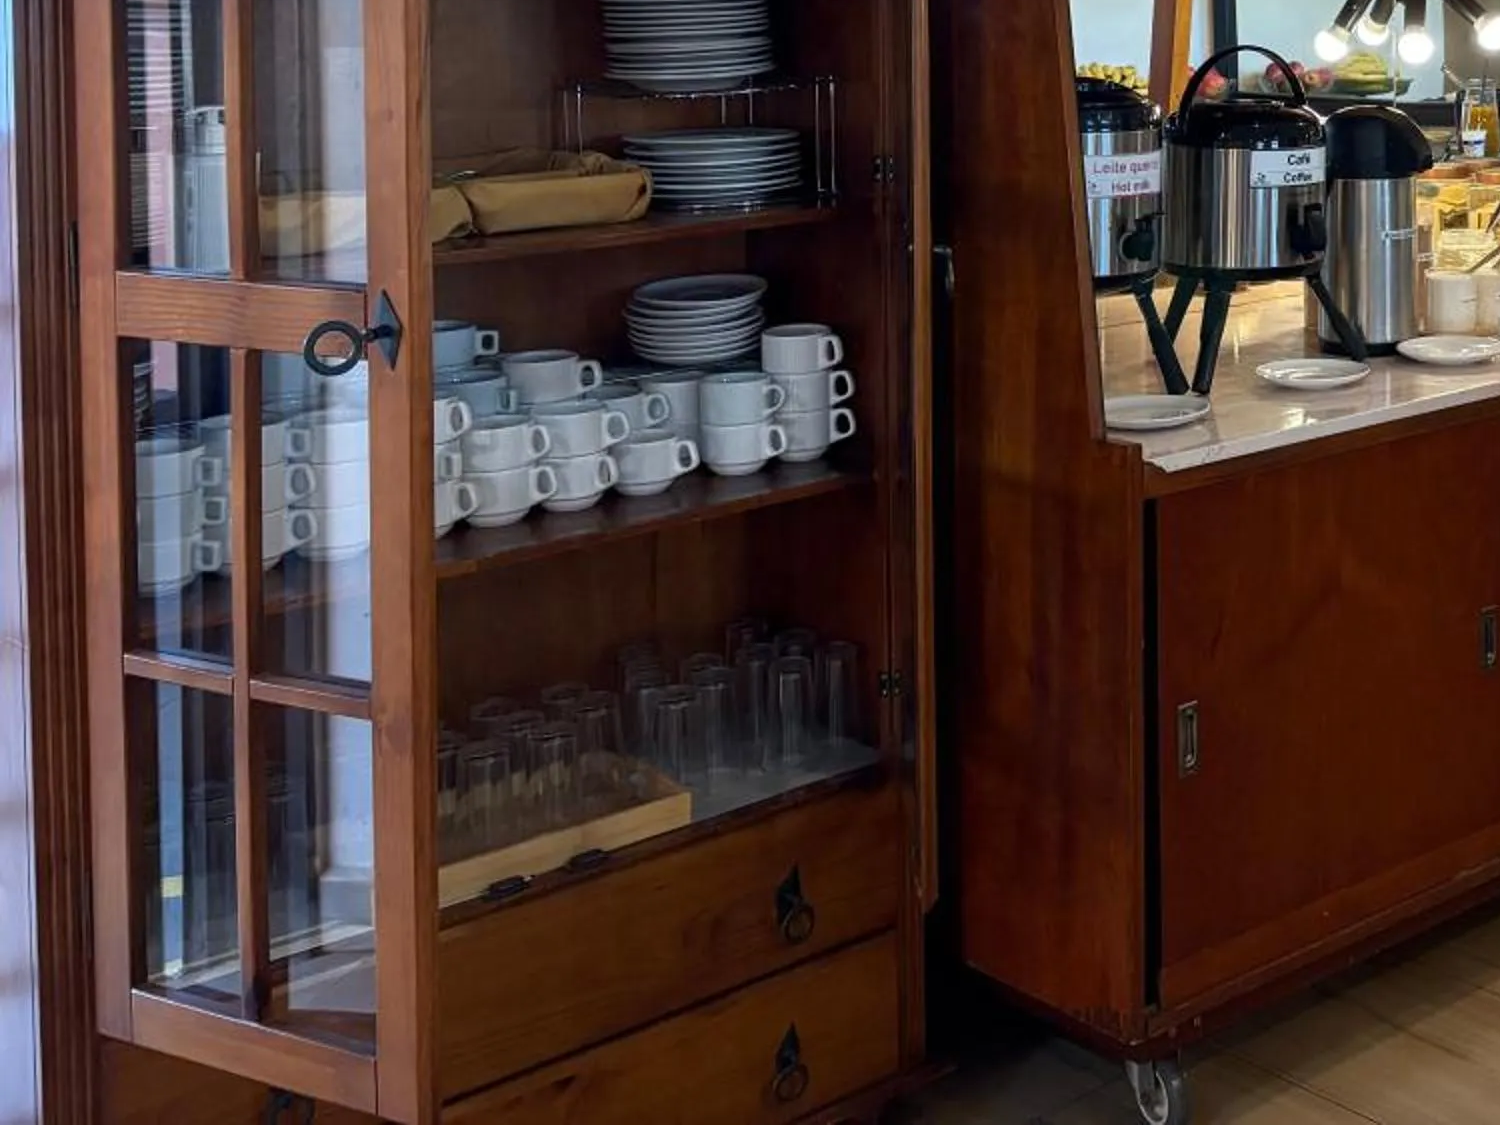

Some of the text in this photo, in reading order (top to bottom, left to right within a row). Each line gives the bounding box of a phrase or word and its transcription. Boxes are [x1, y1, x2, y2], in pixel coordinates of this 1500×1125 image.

[1287, 152, 1311, 166] Café
[1093, 160, 1127, 174] Leite
[1111, 179, 1131, 193] Hot
